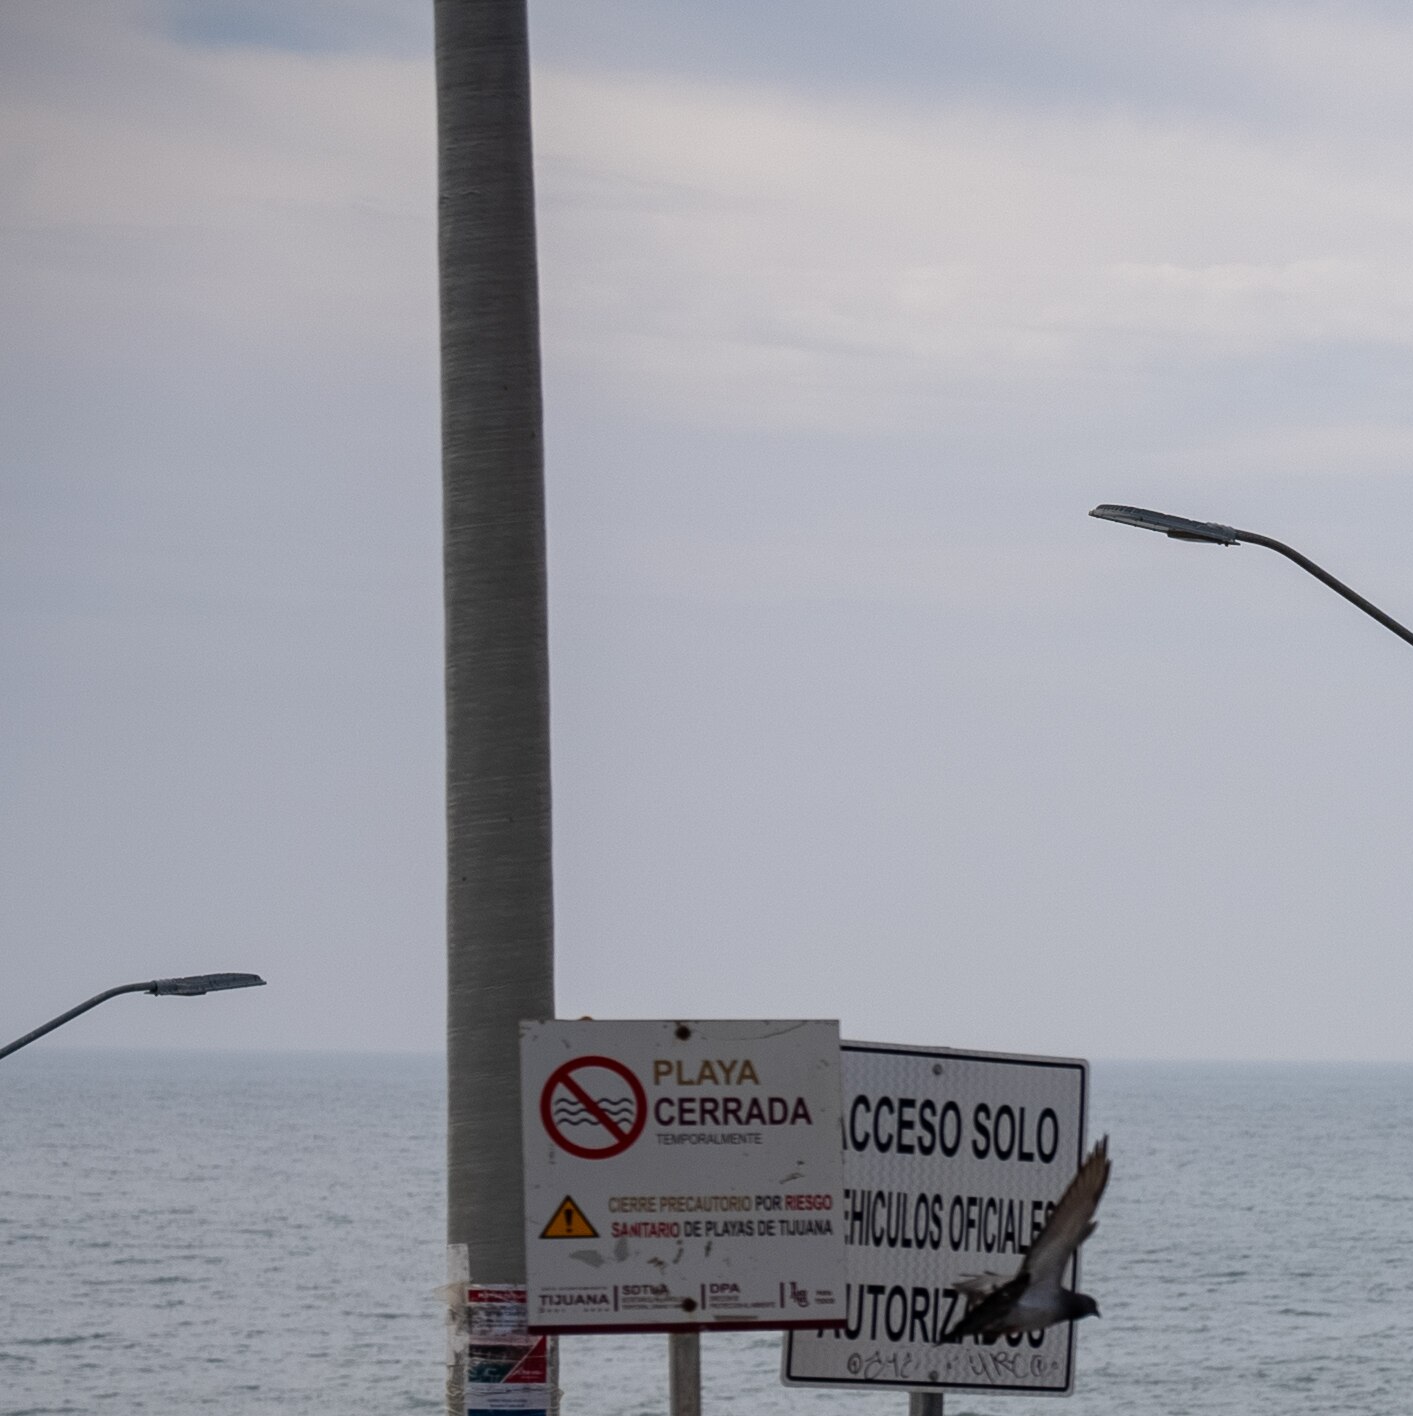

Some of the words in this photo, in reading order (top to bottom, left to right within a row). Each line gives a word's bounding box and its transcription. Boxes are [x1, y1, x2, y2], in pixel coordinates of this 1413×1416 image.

[653, 1059, 761, 1086] PLAYA
[654, 1097, 813, 1126] CERRADA
[840, 1094, 962, 1158] CCESO
[972, 1102, 1059, 1164] SOLO
[656, 1132, 763, 1146] TEMPORALMENTE
[608, 1196, 656, 1213] CIERRE
[659, 1195, 753, 1213] PRECAUTORIO
[755, 1195, 783, 1212] POR
[784, 1194, 833, 1211] RIESGO
[611, 1221, 680, 1238] SANITARIO
[684, 1221, 702, 1237] DE
[705, 1220, 754, 1237] PLAYAS
[757, 1220, 775, 1236] DE
[779, 1219, 833, 1236] TIJUANA
[709, 1283, 740, 1294] DPA
[538, 1294, 610, 1306] TIJUANA
